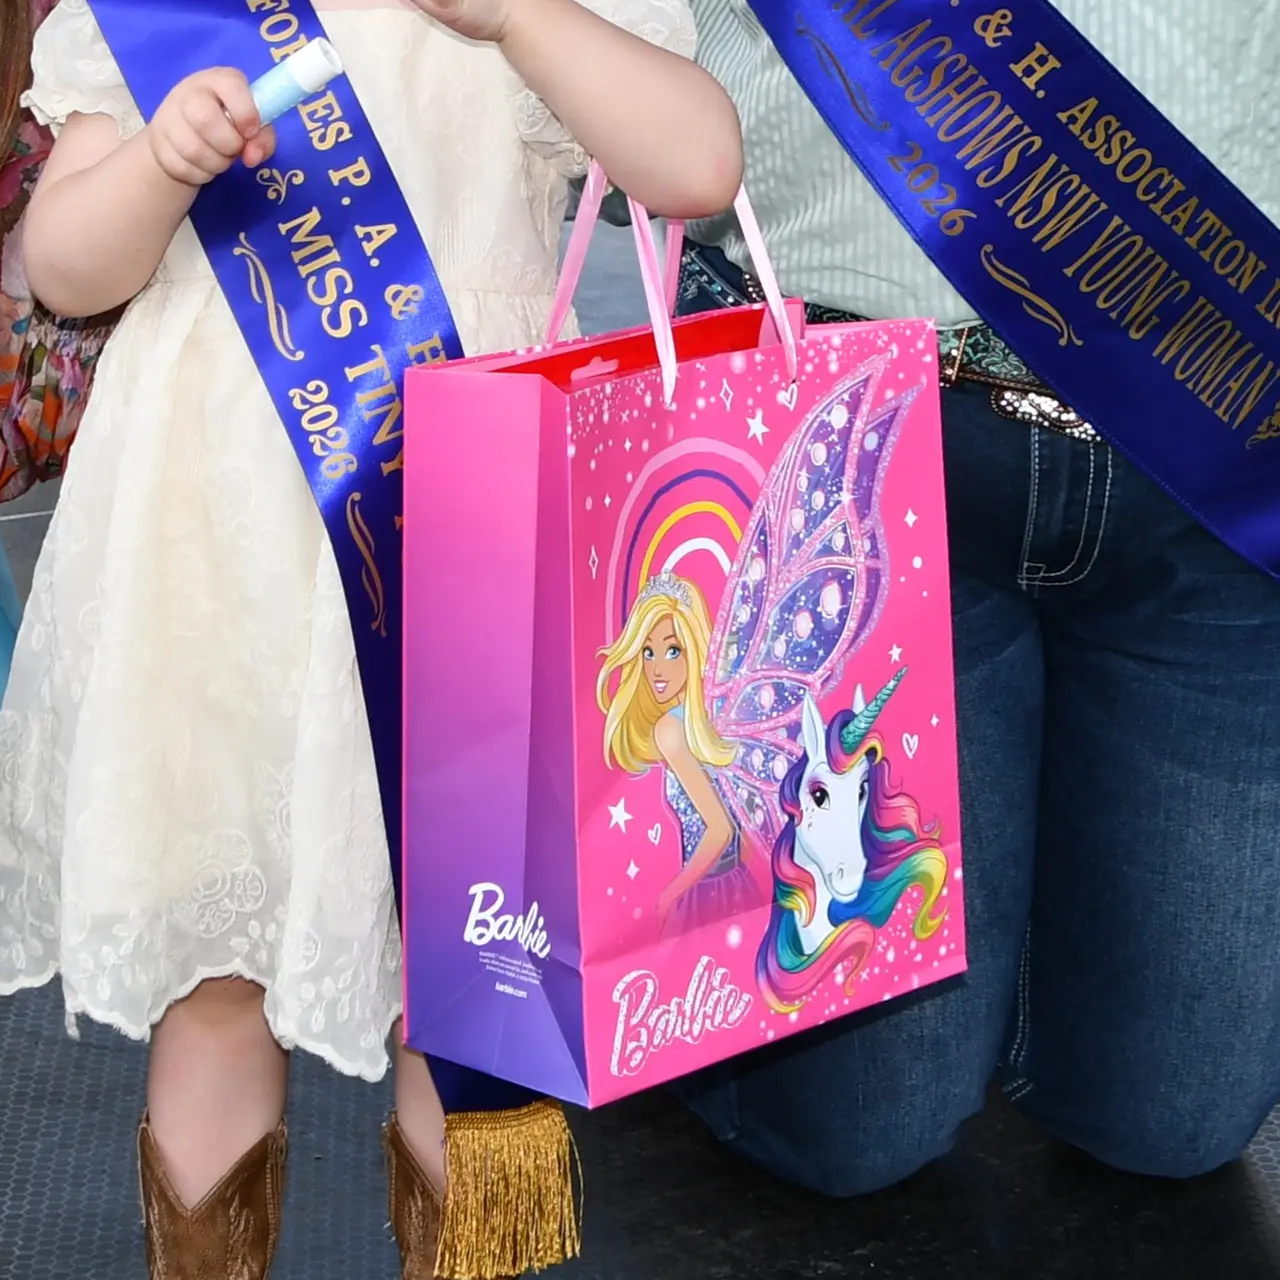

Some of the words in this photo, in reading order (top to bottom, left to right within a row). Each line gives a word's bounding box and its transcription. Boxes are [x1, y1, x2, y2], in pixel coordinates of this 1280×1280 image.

[869, 18, 1043, 189] AGSHOWS
[994, 152, 1109, 254] NSW
[1063, 213, 1192, 341] YOUNG
[887, 140, 978, 237] 2026
[973, 8, 1014, 48] &
[1008, 42, 1062, 99] H.
[1057, 96, 1268, 295] ASSOCIATION
[278, 206, 369, 339] MISS
[328, 156, 372, 206] P.
[355, 222, 398, 268] A.
[384, 283, 423, 322] &
[288, 379, 359, 480] 2026
[463, 882, 551, 959] Barbie
[610, 955, 754, 1078] Barbie
